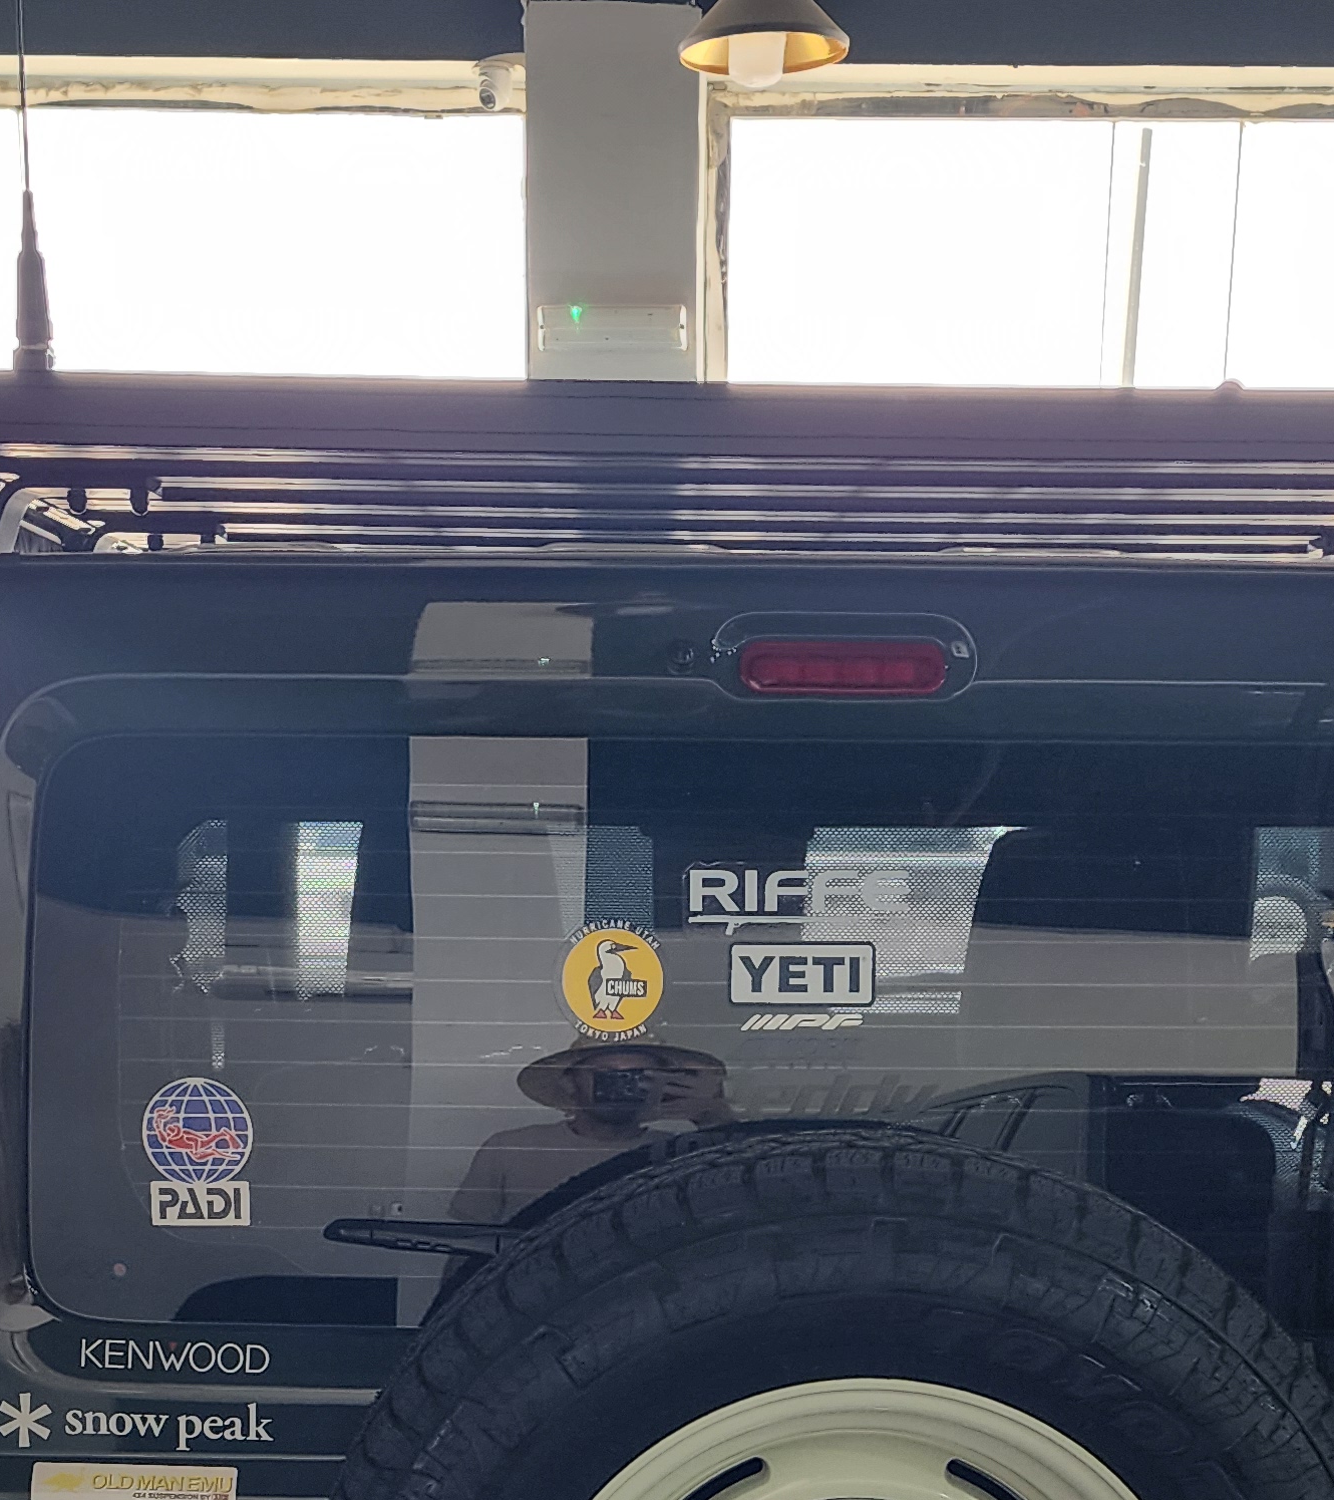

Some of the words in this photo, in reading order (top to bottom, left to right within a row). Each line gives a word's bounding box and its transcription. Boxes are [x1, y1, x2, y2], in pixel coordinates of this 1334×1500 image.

[688, 868, 912, 913] RIFFE
[569, 919, 631, 945] HURRICANE
[635, 926, 662, 950] UTAH
[607, 979, 645, 996] CHUMS
[738, 955, 861, 993] YETI
[573, 1019, 609, 1041] TOKYO
[613, 1023, 648, 1042] JAPAN
[157, 1187, 242, 1221] PADI
[79, 1338, 271, 1374] KENWOOD
[64, 1408, 170, 1438] snow
[175, 1402, 275, 1452] peak
[92, 1473, 134, 1490] OLD
[136, 1474, 185, 1491] MAN
[186, 1475, 234, 1493] EMU
